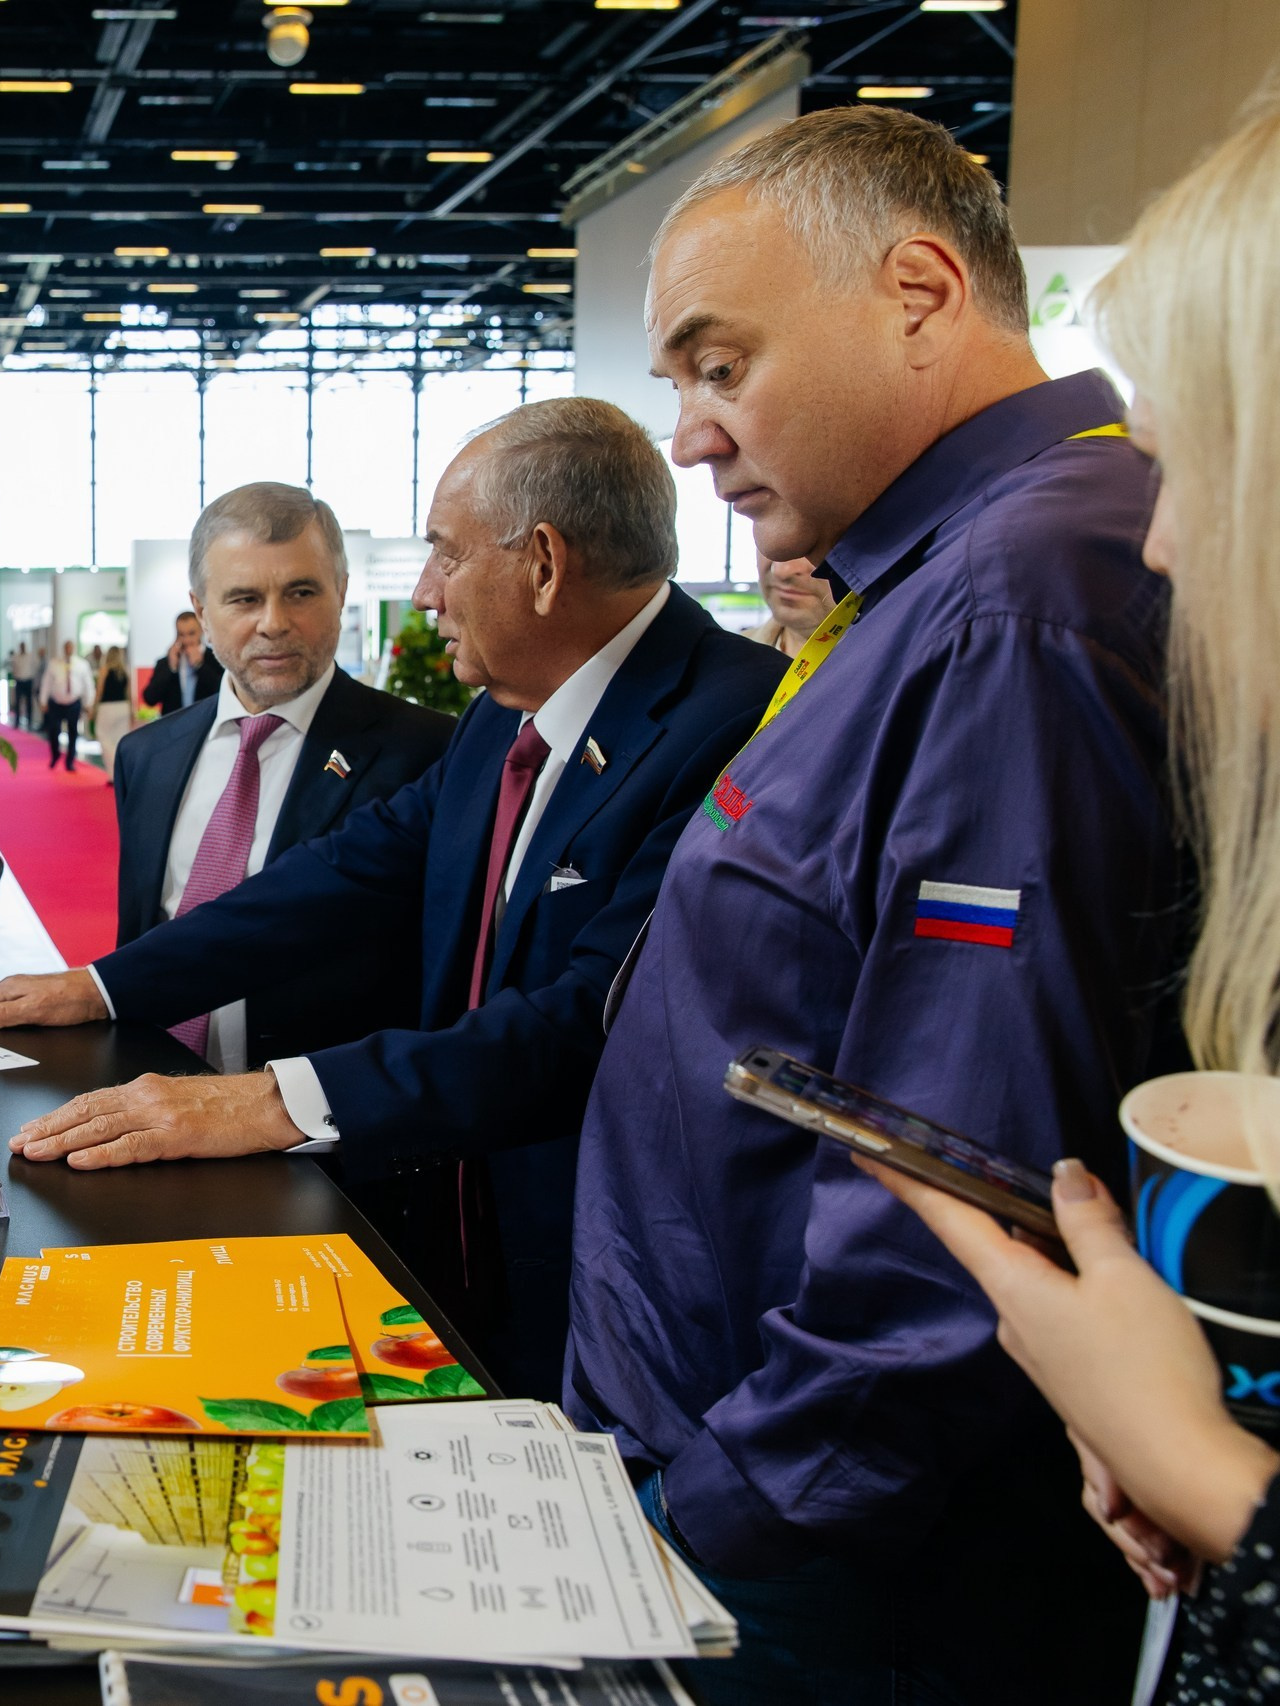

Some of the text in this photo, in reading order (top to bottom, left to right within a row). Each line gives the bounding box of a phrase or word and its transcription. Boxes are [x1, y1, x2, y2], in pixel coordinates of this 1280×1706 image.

[15, 1265, 39, 1305] MAGNUS
[117, 1280, 143, 1352] СТРОИТЕЛЬСТВО
[173, 1270, 196, 1352] ФРУКТОХРАНИЛИЩ
[145, 1288, 167, 1352] СОВРЕМЕННЫХ
